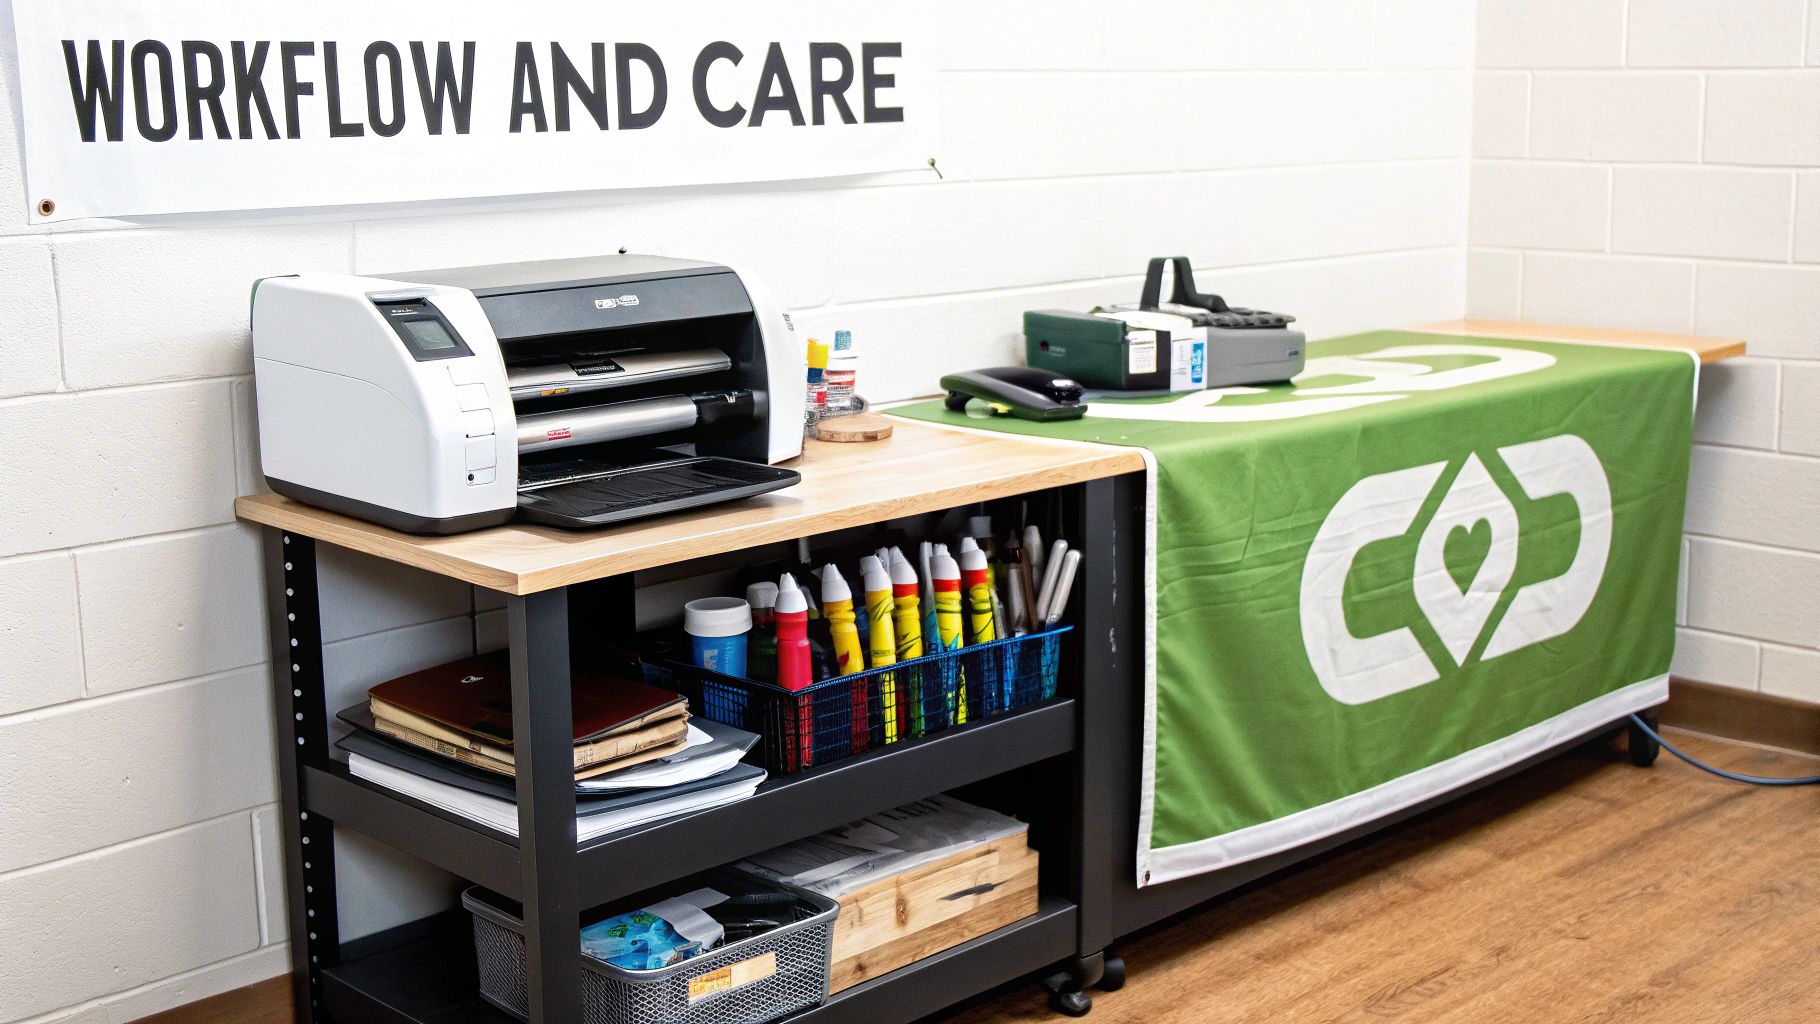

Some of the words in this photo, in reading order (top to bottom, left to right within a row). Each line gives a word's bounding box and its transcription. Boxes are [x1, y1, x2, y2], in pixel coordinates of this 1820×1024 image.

[61, 39, 476, 143] WORKFLOW
[509, 41, 668, 133] AND
[692, 40, 904, 128] CARE
